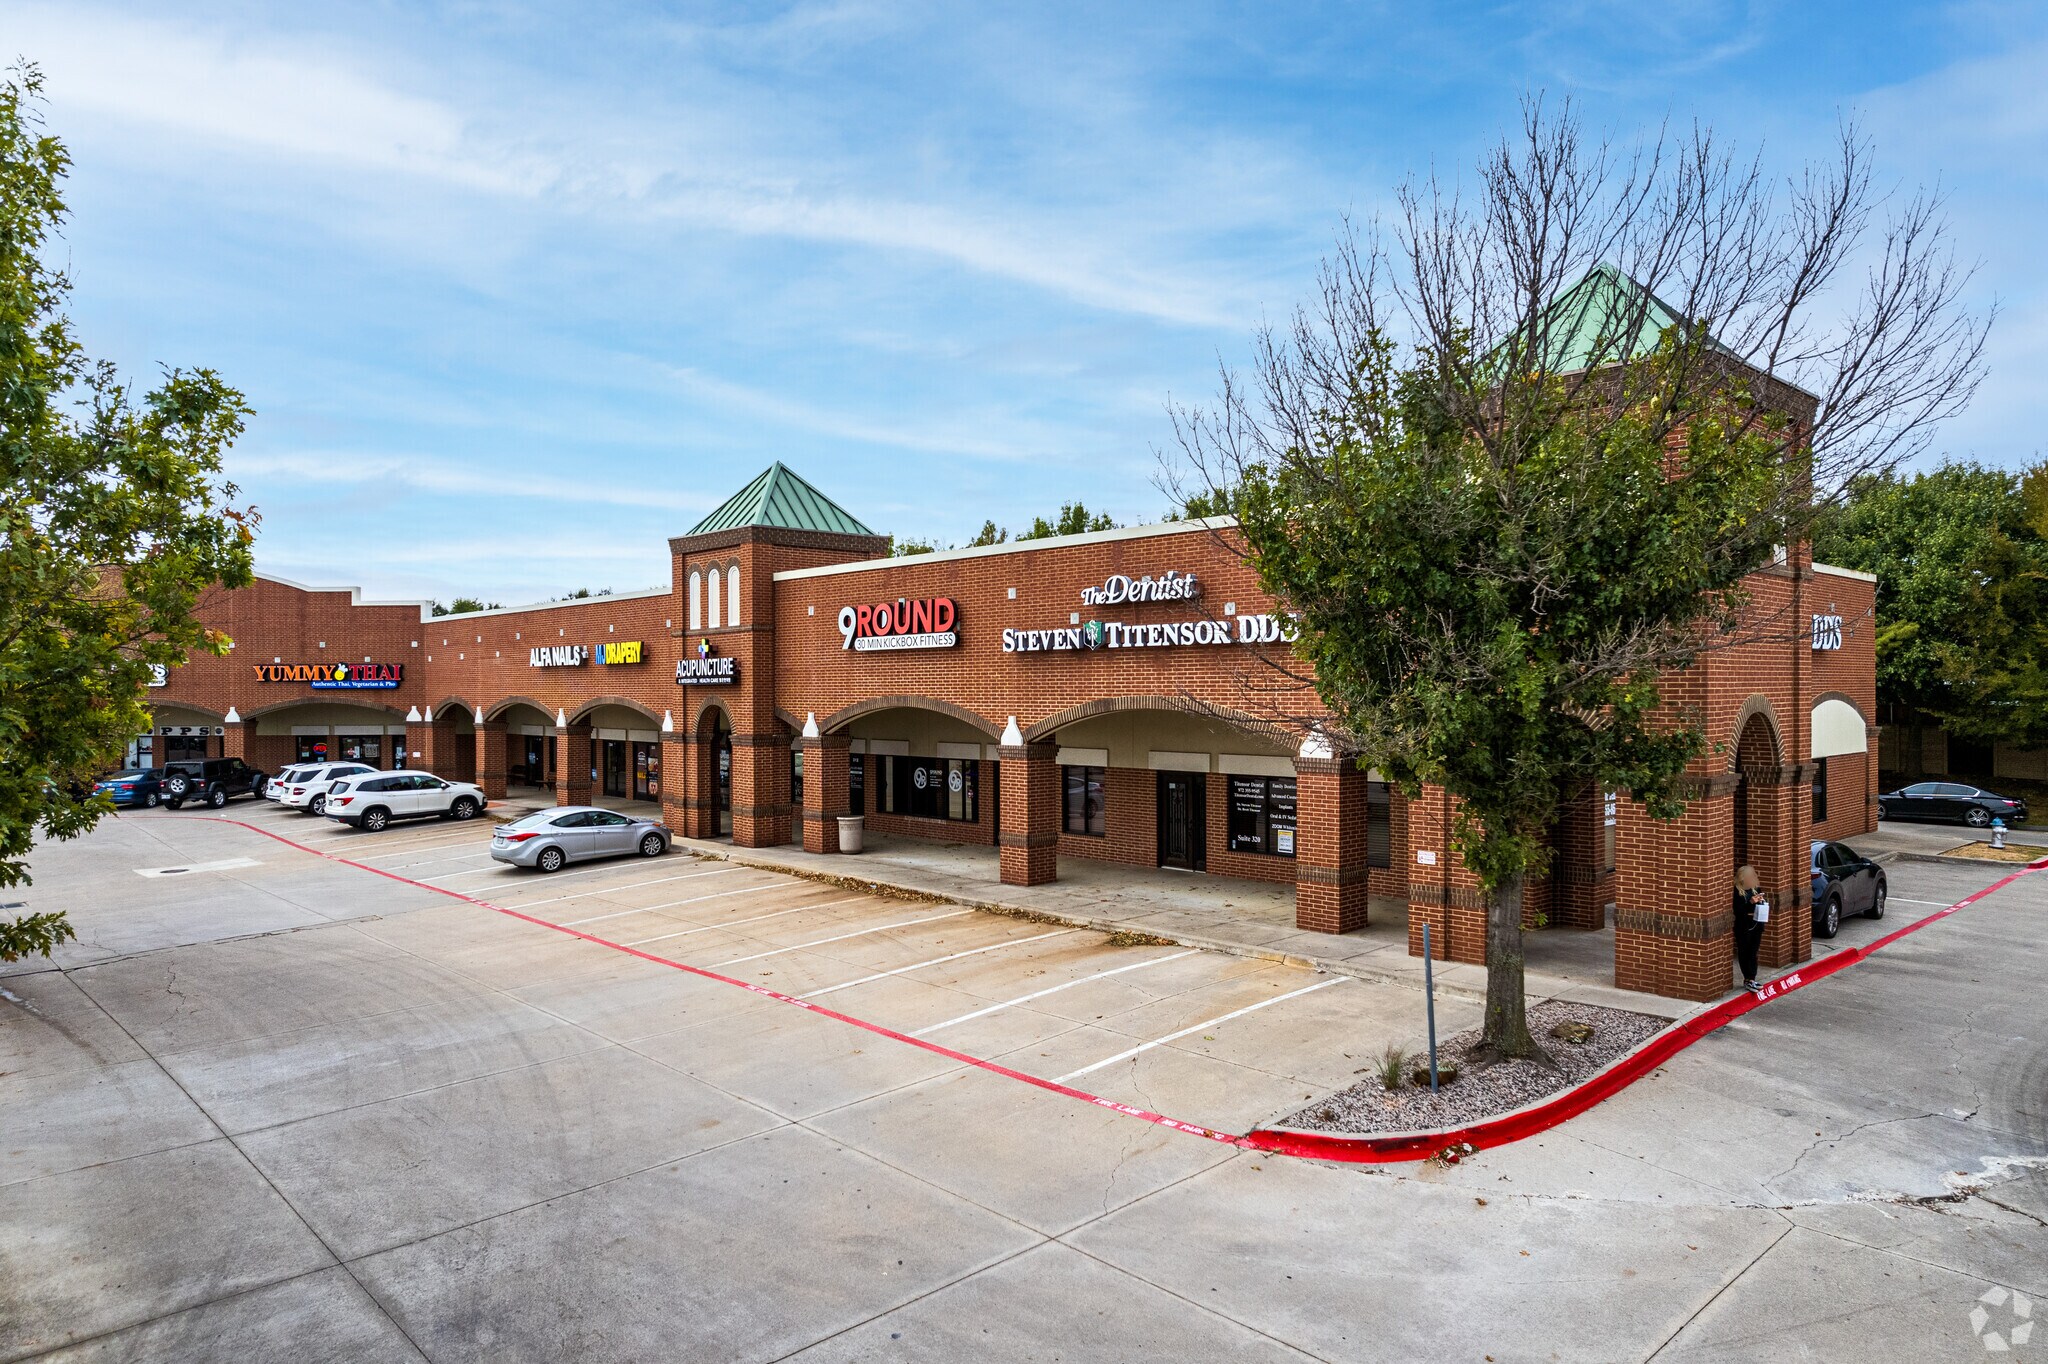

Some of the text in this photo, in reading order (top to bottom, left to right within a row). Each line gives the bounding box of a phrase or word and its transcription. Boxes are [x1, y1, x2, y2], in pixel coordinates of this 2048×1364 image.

[1080, 570, 1194, 606] The Dentist
[856, 633, 954, 650] 30 MIN KICKBOX FITNESS
[1002, 620, 1231, 653] STEVEN TITENSOR
[1812, 614, 1842, 650] DDS
[530, 645, 581, 667] ALFA NAILS
[605, 641, 641, 664] DRAPERY
[253, 664, 401, 682] YUMMY THAI
[676, 657, 734, 677] ACUPUNCTURE
[1161, 1119, 1178, 1127] NO
